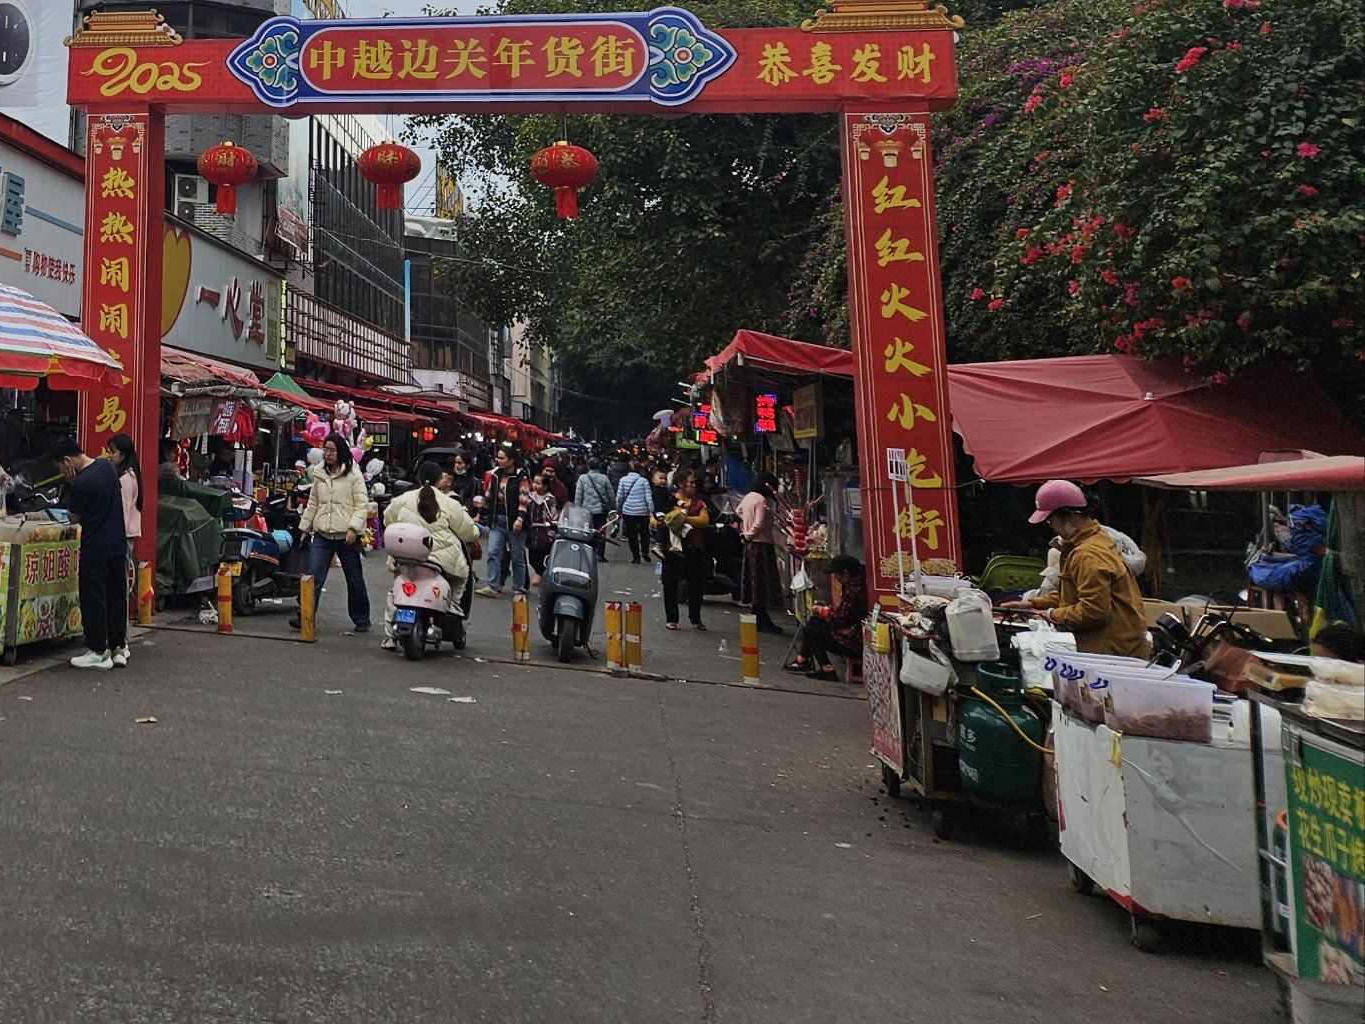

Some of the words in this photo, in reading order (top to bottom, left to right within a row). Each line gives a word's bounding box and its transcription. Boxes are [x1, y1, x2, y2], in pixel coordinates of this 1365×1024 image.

[82, 47, 206, 97] 2025
[309, 36, 637, 80] 中越边关年货街
[757, 42, 936, 87] 恭喜发财
[871, 175, 944, 550] 红红火火小吃街
